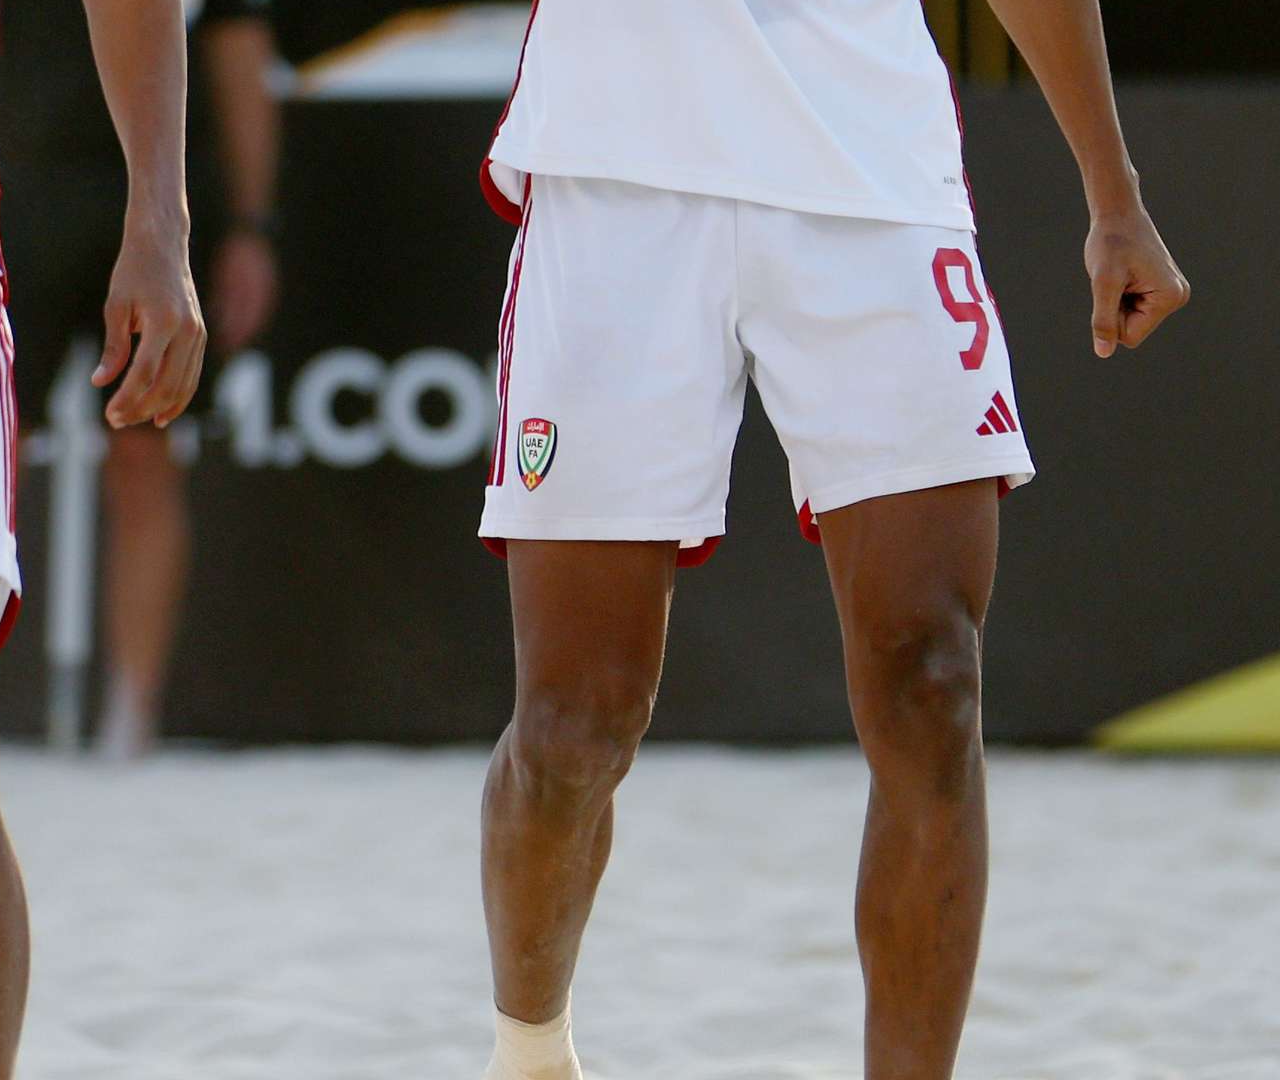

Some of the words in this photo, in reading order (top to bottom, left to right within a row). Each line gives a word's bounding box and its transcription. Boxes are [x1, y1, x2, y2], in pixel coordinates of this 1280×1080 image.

[933, 249, 988, 370] 9
[525, 438, 544, 449] UAE
[528, 449, 538, 458] FA
